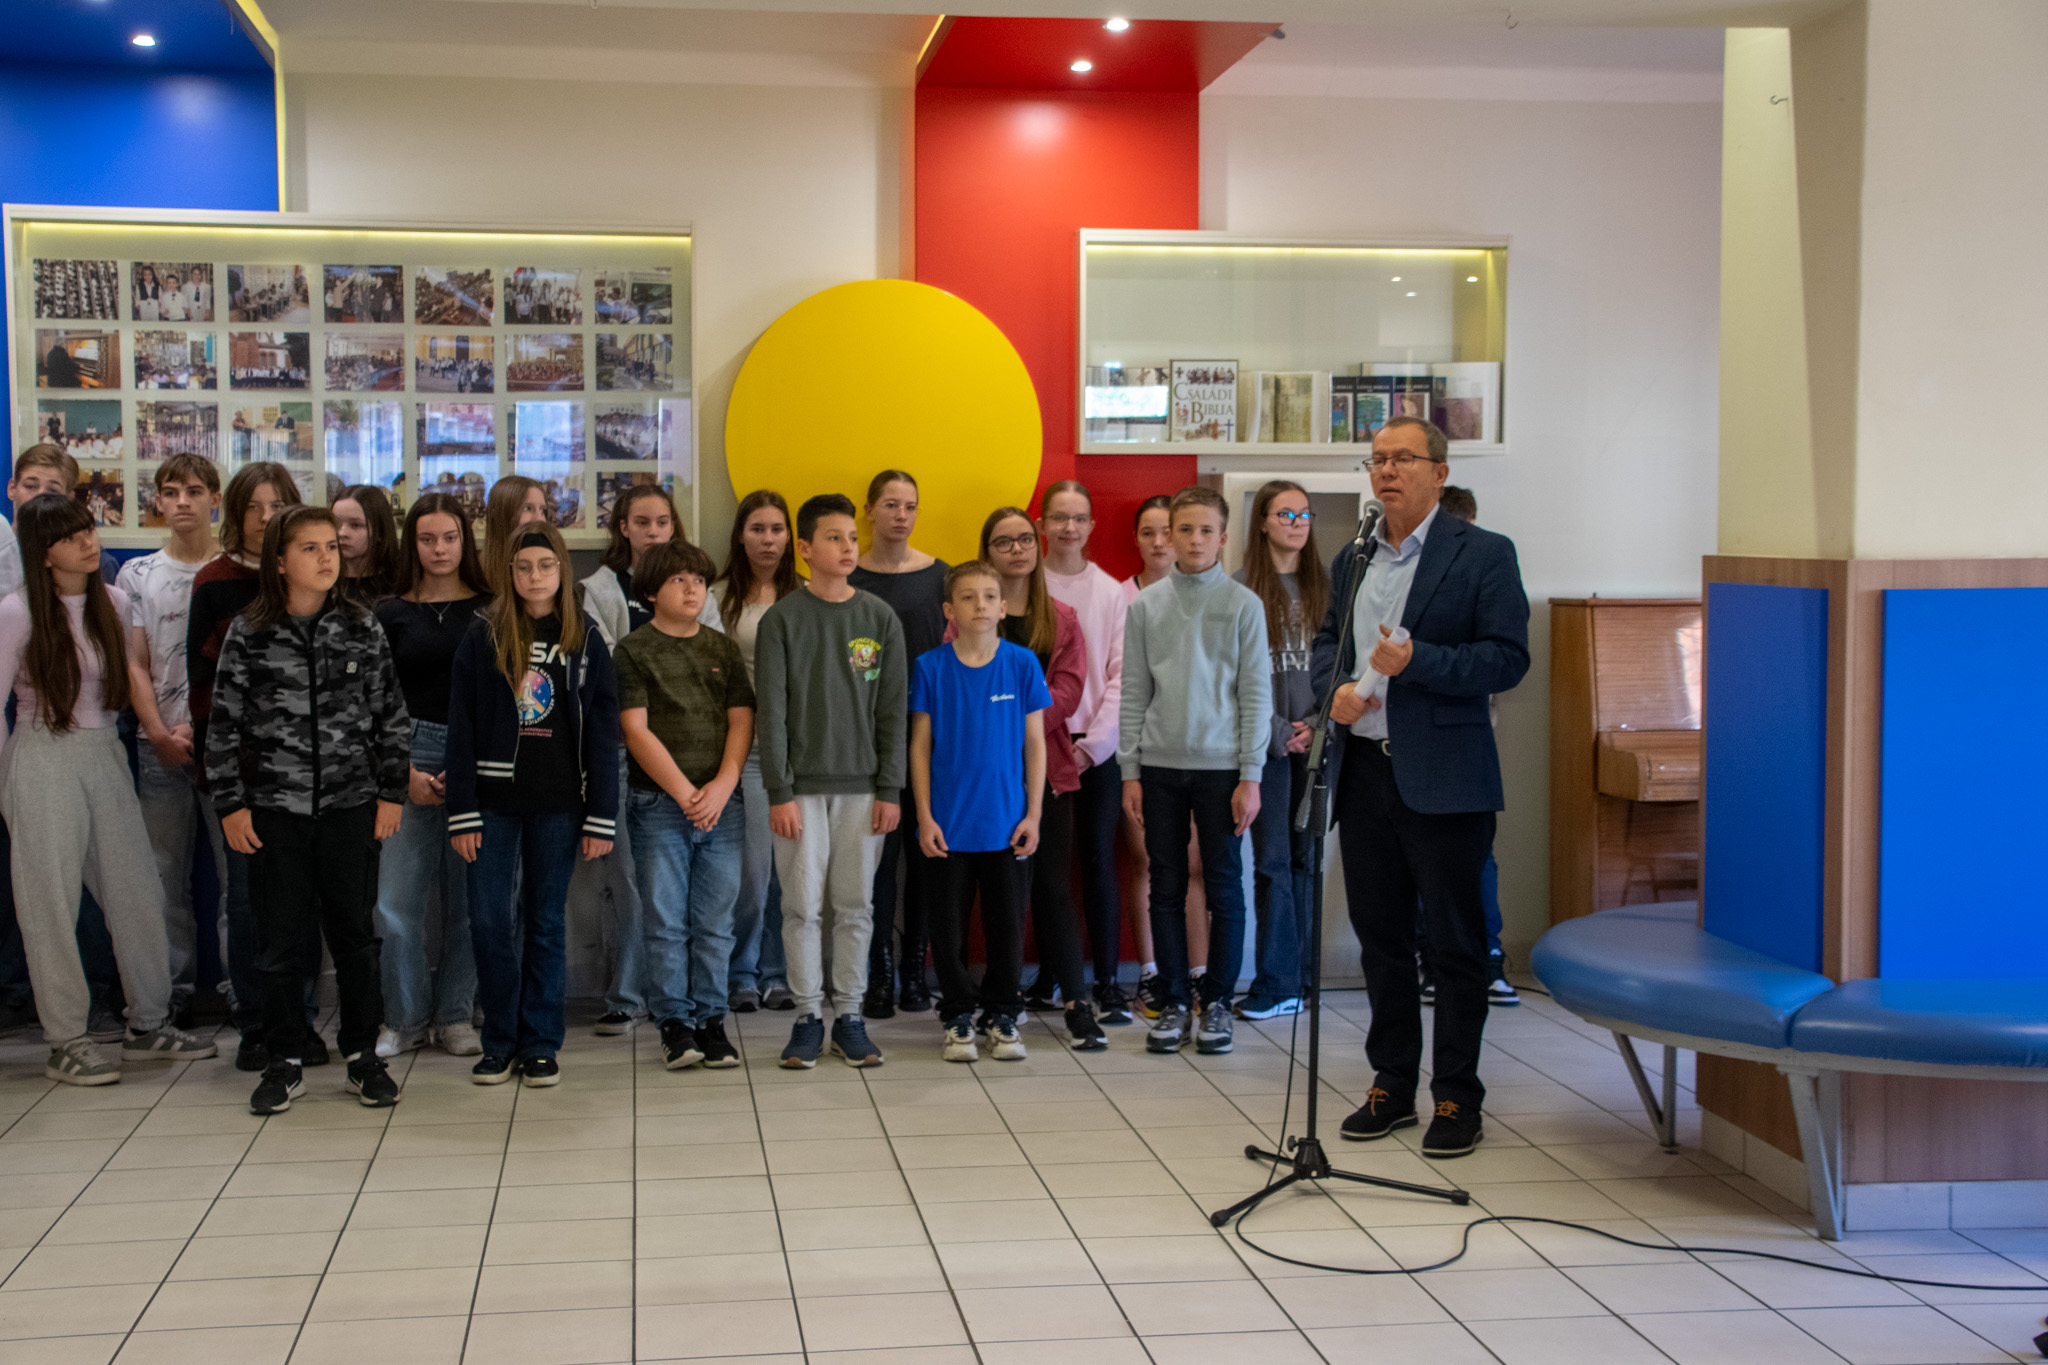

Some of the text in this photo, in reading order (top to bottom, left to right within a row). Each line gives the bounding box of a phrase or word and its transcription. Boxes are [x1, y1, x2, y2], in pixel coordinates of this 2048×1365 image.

[1191, 401, 1234, 424] BIBLIA
[530, 641, 566, 665] SA
[539, 668, 555, 696] NATIONAL
[524, 698, 555, 726] AERONAUTICS
